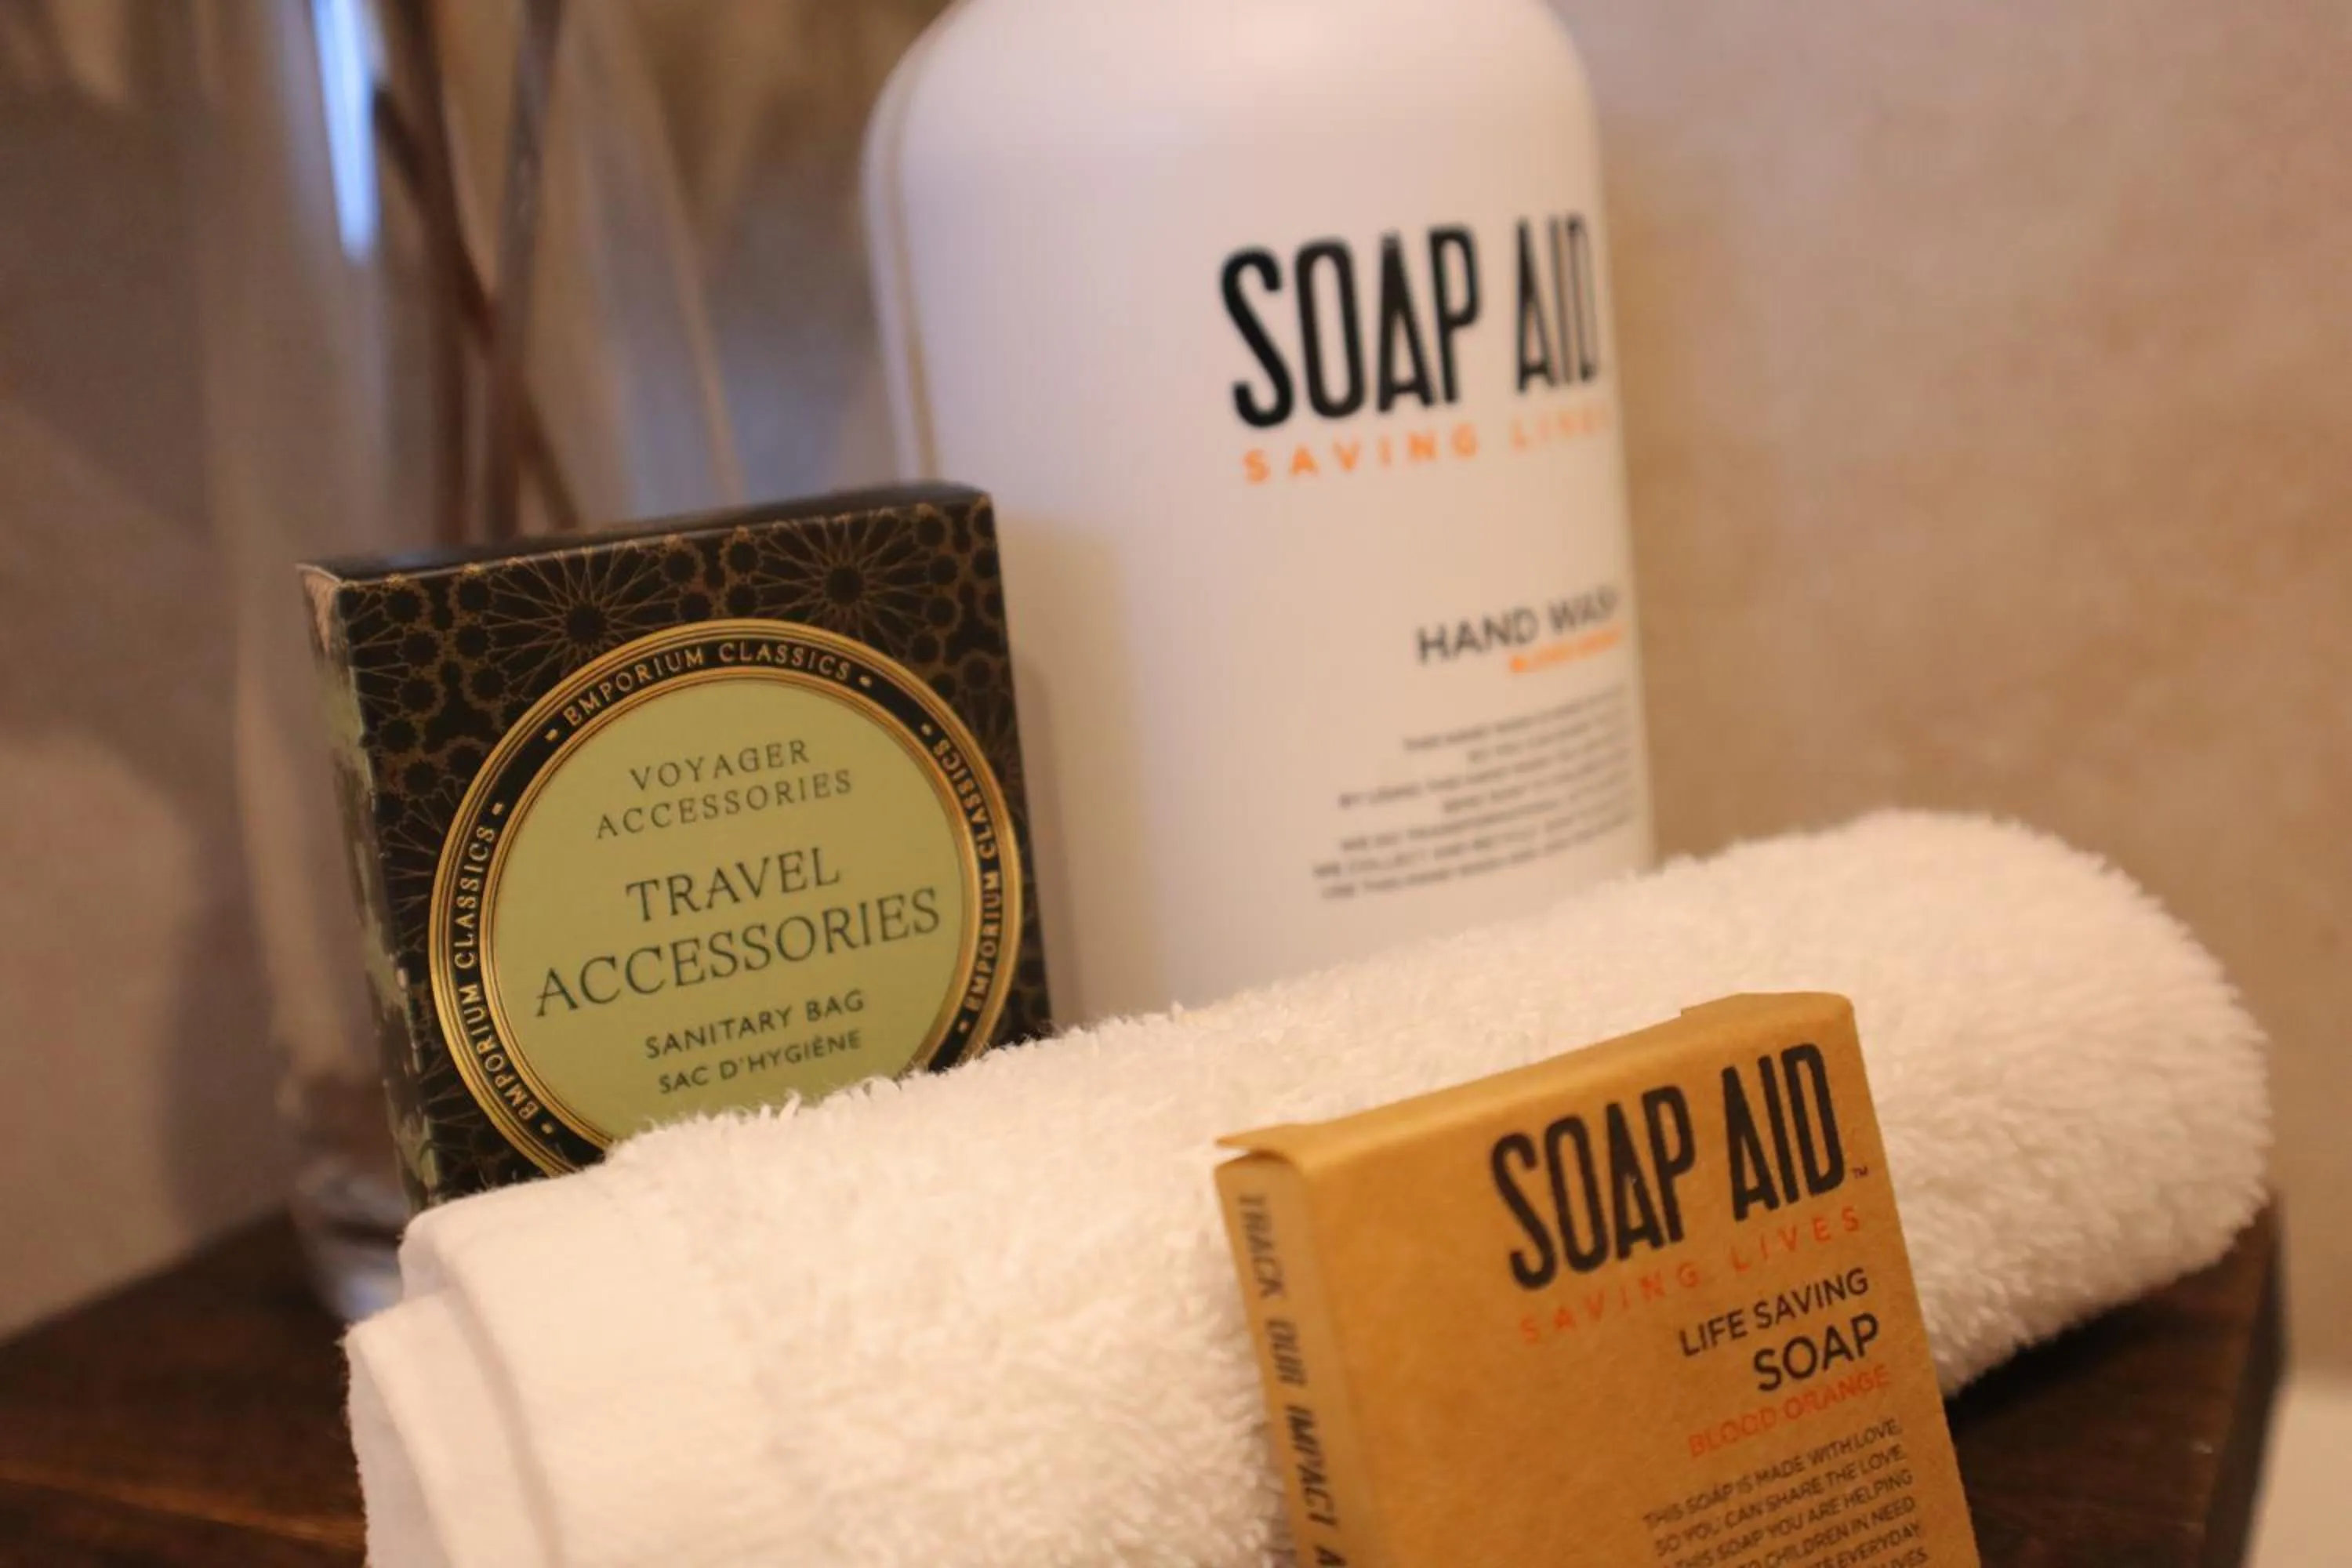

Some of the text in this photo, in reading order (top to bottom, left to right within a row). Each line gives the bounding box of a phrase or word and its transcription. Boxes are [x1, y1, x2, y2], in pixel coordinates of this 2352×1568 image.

[1221, 210, 1599, 428] SOAP AID
[1243, 423, 1479, 485] SAVING
[1416, 605, 1541, 666] HAND
[563, 643, 851, 727] EMPORIUM CLASSICS
[597, 769, 852, 839] ACCESSORIES
[630, 739, 809, 791] VOYAGER
[626, 847, 840, 923] TRAVEL
[933, 739, 1002, 1011] EMPORIUM CLASSICS
[454, 826, 539, 1120] EMPORIUM CLASSICS
[535, 887, 942, 1018] ACCESSORIES
[644, 989, 865, 1059] SANITARY BAG
[658, 1067, 710, 1094] SAC
[1491, 1084, 1696, 1291] SOAP
[1722, 1044, 1845, 1222] AID
[1520, 1207, 1860, 1344] SAVING LIVES
[1679, 1267, 1868, 1357] LIFE SAVING
[1238, 1193, 1287, 1300] TRACK
[1285, 1403, 1340, 1529] IMPACT
[1753, 1312, 1878, 1392] SOAP
[1688, 1364, 1891, 1458] BLOOD ORANGE
[1642, 1502, 1684, 1530] THIS
[1685, 1481, 1733, 1514] SOAP
[1754, 1455, 1806, 1486] MADE
[1807, 1434, 1853, 1466] WITH
[1654, 1534, 1681, 1558] SO
[1724, 1503, 1762, 1529] CAN
[1766, 1475, 1824, 1512] SHARE
[1824, 1461, 1858, 1487] THE
[1715, 1530, 1763, 1561] SOAP
[1765, 1510, 1803, 1538] YOU
[1808, 1497, 1841, 1523] ARE
[1844, 1468, 1914, 1508] HELPING
[1764, 1523, 1849, 1568] CHILDREN
[1850, 1513, 1870, 1534] IN
[1871, 1495, 1916, 1525] NEED
